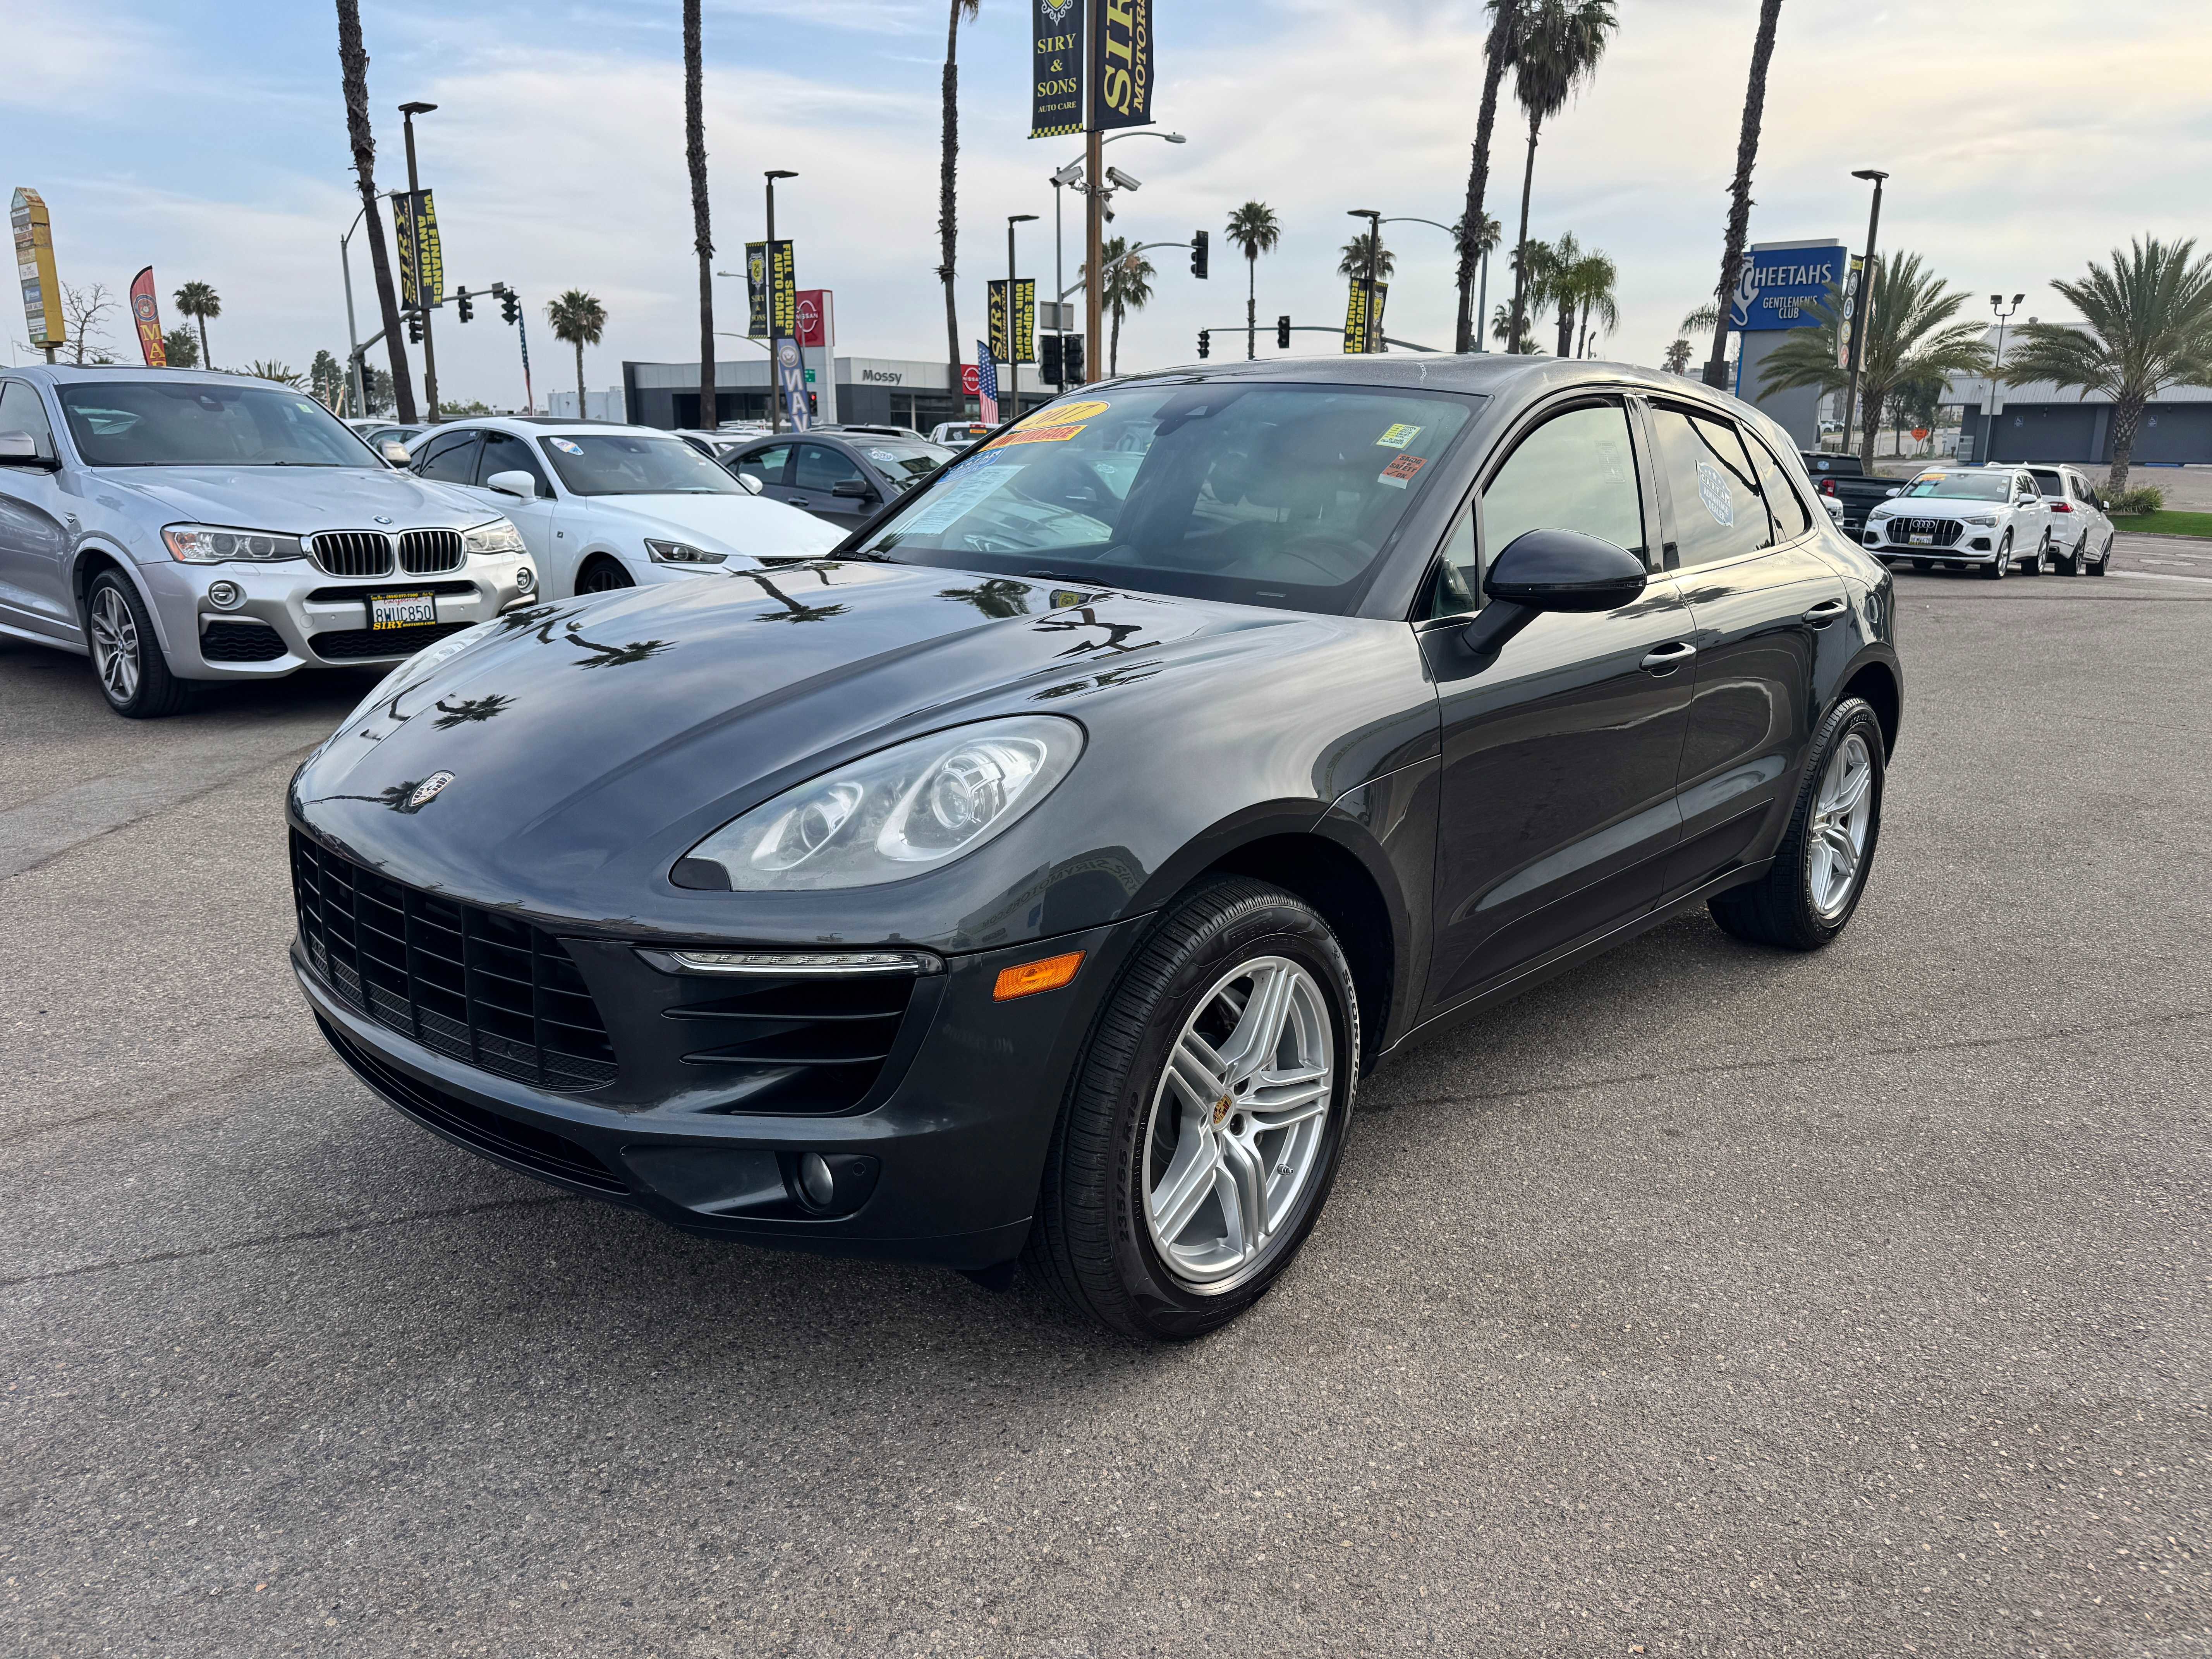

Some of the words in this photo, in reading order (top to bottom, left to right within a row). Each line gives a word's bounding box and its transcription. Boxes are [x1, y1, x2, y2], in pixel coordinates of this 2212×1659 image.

[1037, 33, 1077, 54] SIRY
[1050, 59, 1063, 72] &
[1037, 77, 1077, 97] SONS
[1038, 103, 1056, 113] AUTO
[1058, 101, 1077, 110] CARE
[424, 194, 436, 225] WE
[418, 215, 433, 287] ANYONE
[783, 244, 792, 274] FULL
[429, 229, 442, 305] FINANCE
[774, 253, 784, 289] AUTO
[1015, 283, 1024, 309] OUR
[1025, 282, 1033, 302] WE
[775, 292, 784, 327] CARE
[785, 280, 794, 336] SERVICE
[1346, 280, 1359, 335] SERVICE
[1356, 289, 1366, 324] CARE
[1778, 307, 1799, 319] CLUB
[991, 285, 1003, 360] SIRY
[1015, 311, 1024, 361] TROOPS
[1024, 304, 1033, 361] SUPPORT
[862, 369, 902, 385] Mossy
[1020, 404, 1100, 428] 2017
[1010, 426, 1081, 444] MILEAGE
[1389, 463, 1417, 473] SAFETY
[1400, 455, 1422, 465] SMOG
[1700, 472, 1731, 507] CARFAX
[1704, 487, 1729, 515] ADVANTAGE
[1709, 500, 1725, 521] DEALER
[376, 605, 431, 622] 8WUC850
[1116, 1148, 1130, 1243] 235/55
[1123, 1091, 1139, 1143] R19
